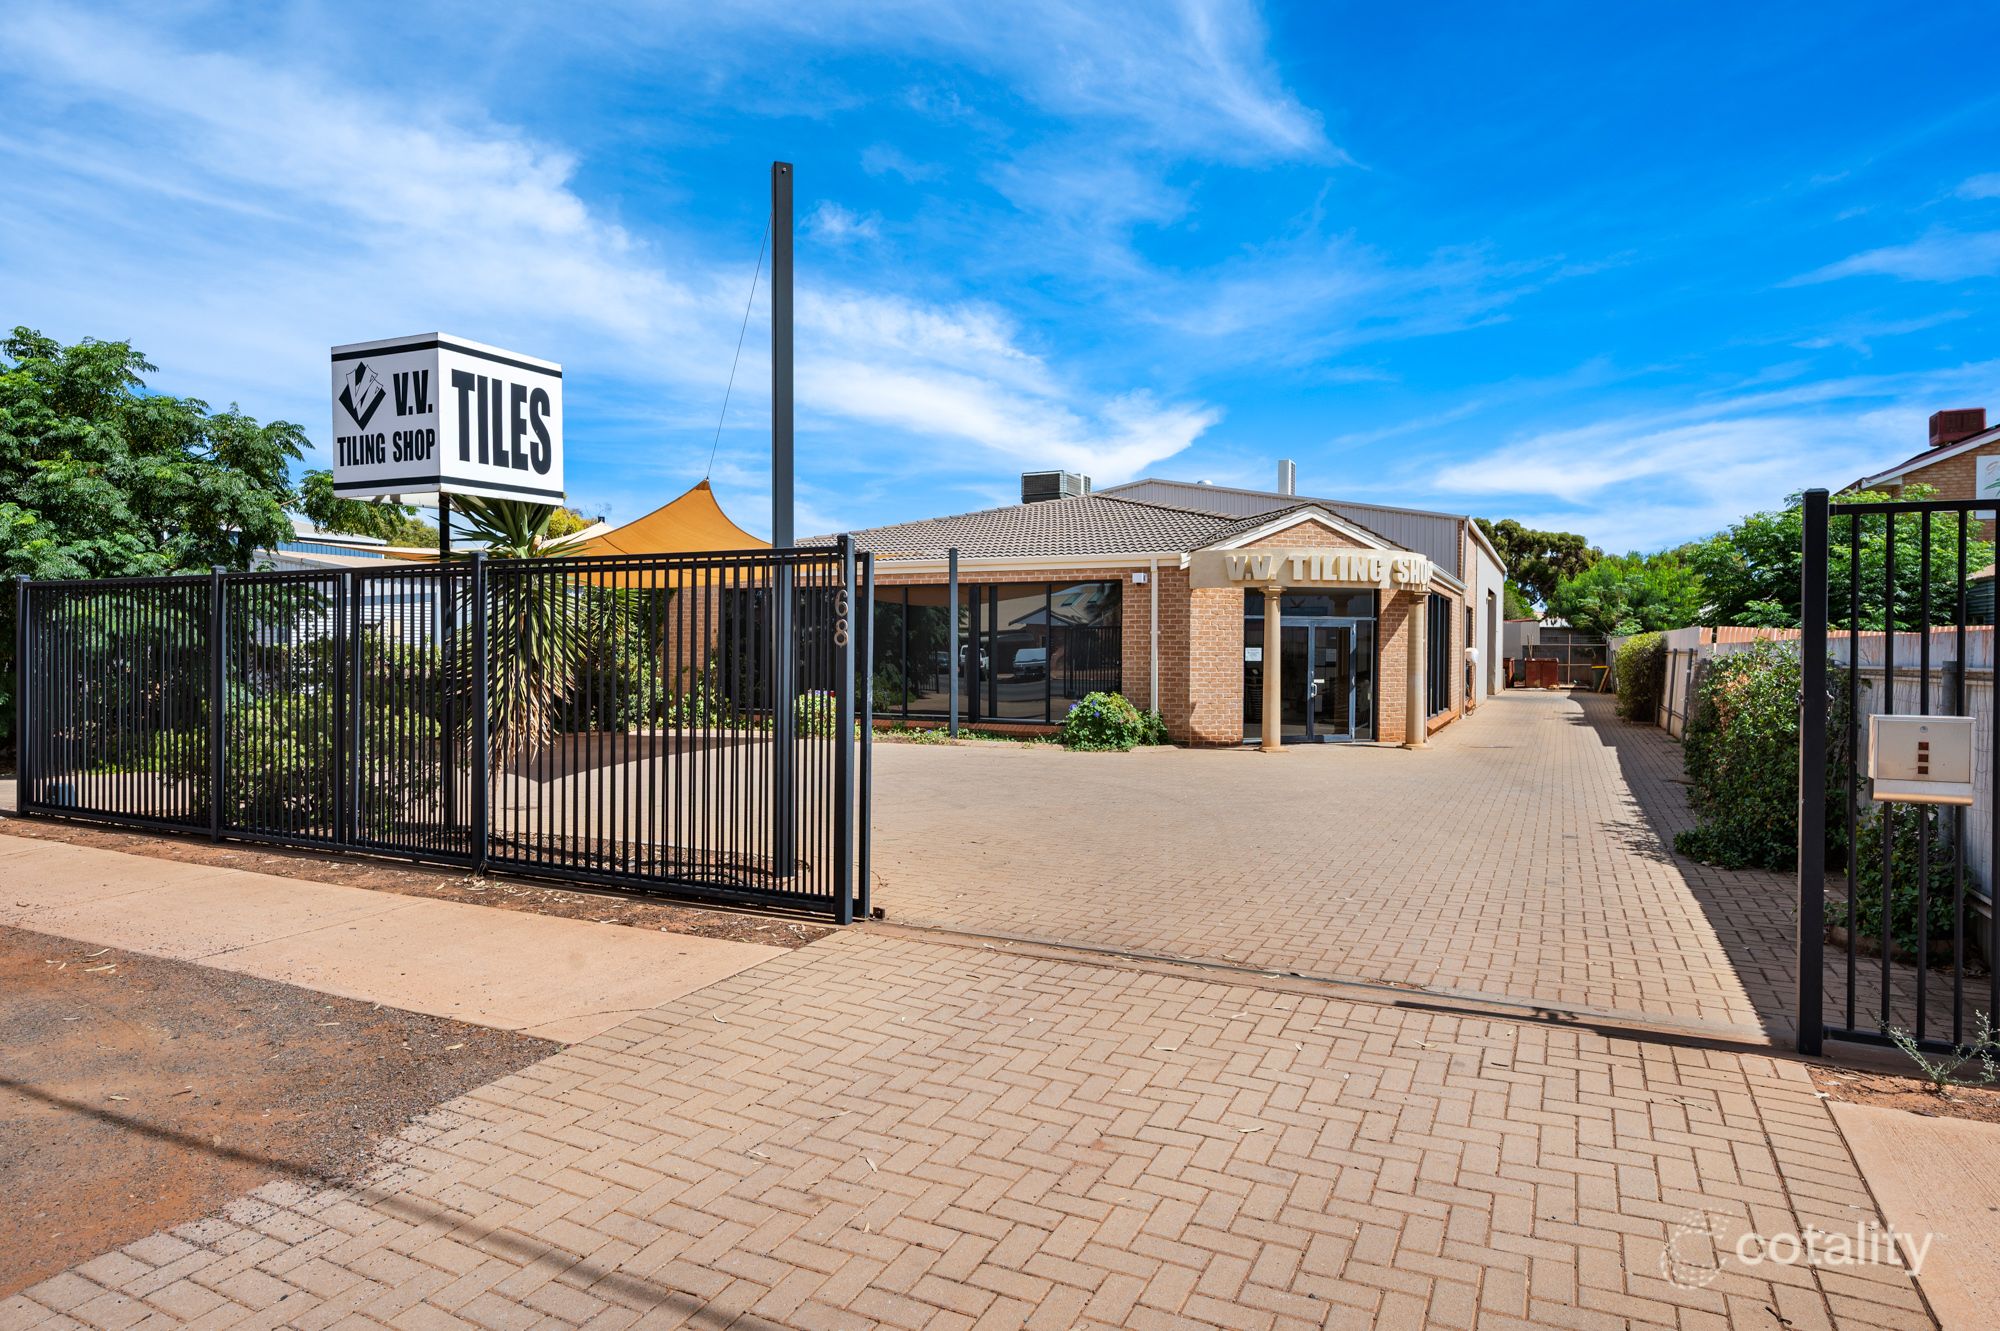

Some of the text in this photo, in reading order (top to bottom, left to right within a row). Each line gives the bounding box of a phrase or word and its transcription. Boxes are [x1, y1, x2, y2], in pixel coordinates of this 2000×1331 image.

[393, 369, 433, 416] V.V.
[451, 368, 552, 475] TILES
[337, 428, 436, 467] TILING SHOP
[1288, 554, 1382, 583] TILING
[1393, 557, 1431, 586] SHO
